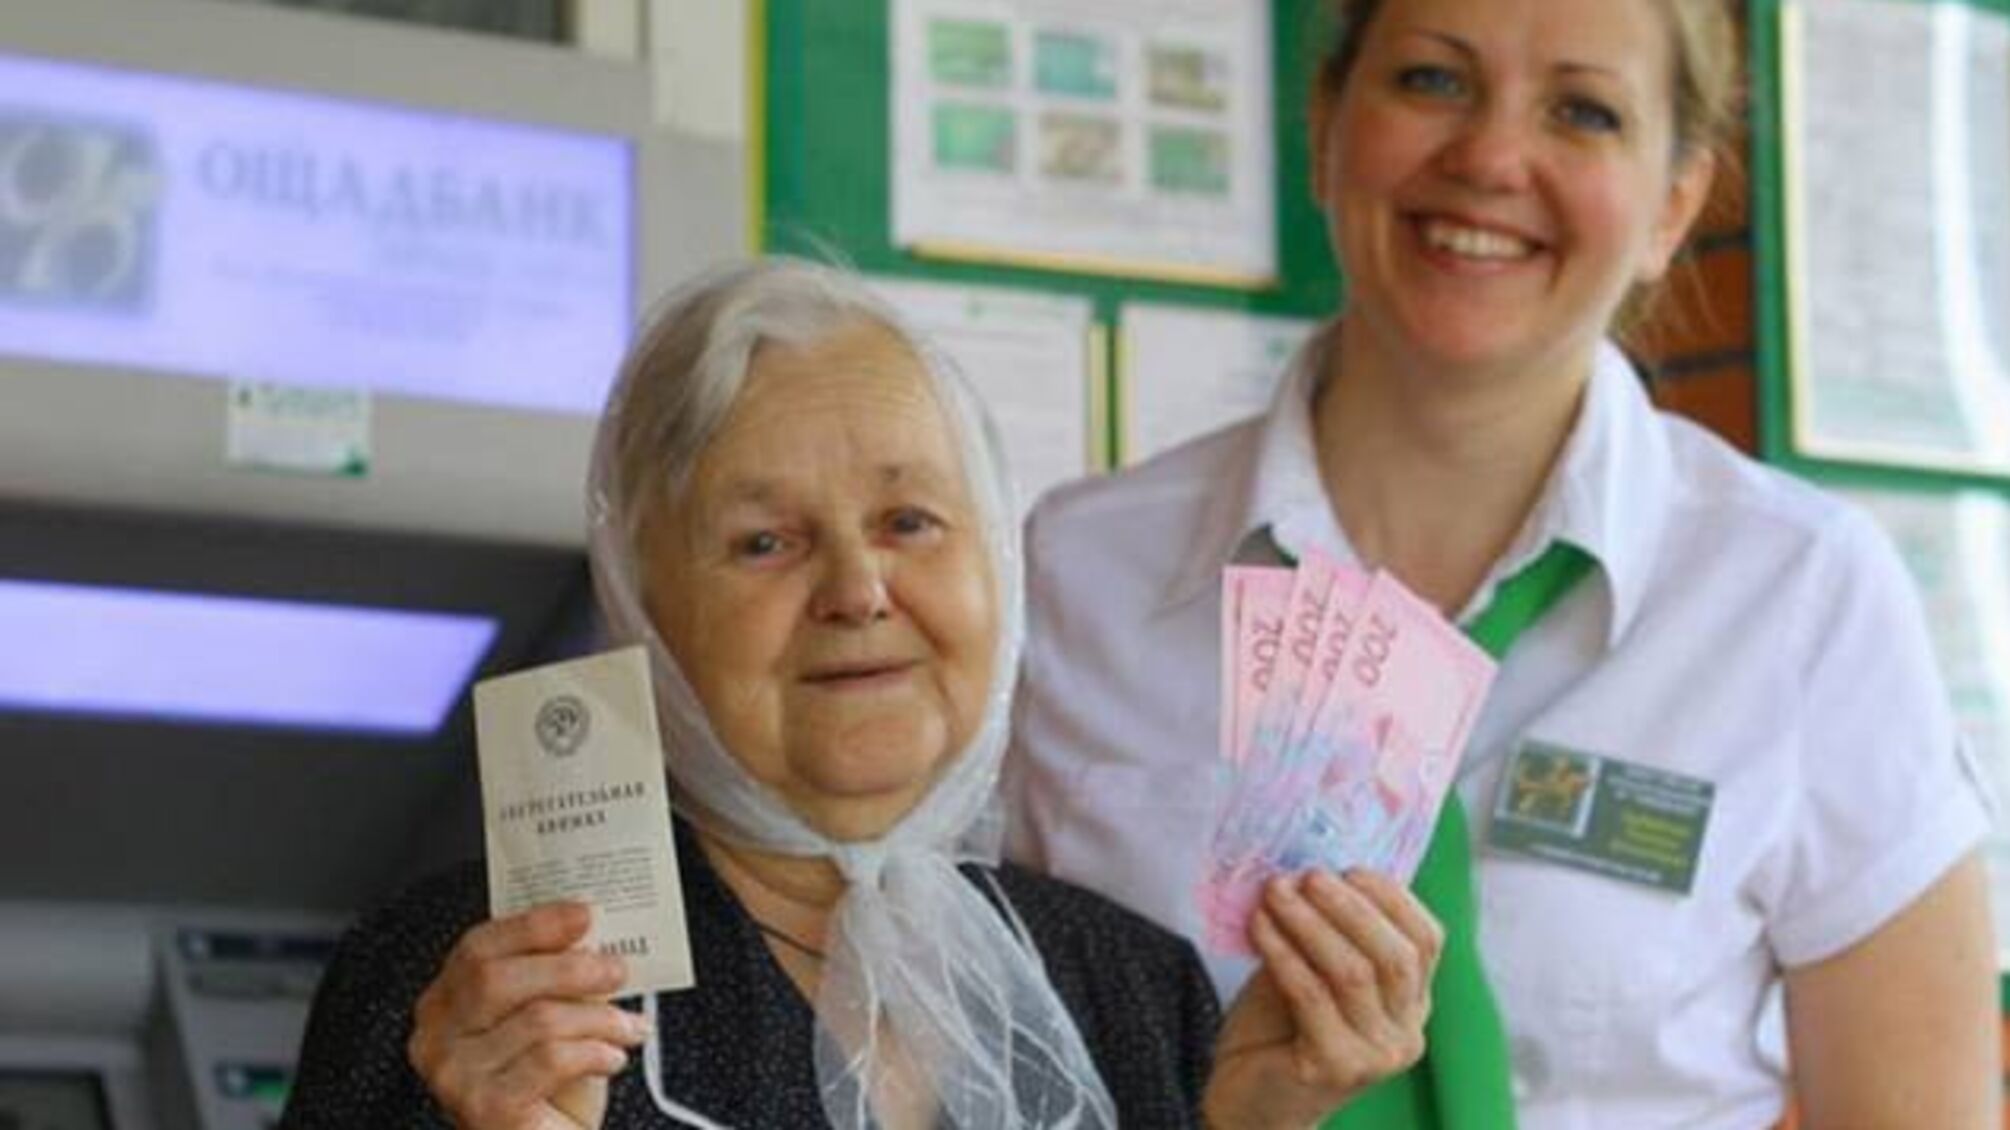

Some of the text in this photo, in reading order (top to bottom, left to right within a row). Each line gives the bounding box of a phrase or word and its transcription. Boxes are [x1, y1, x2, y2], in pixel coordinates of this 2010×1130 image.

[199, 142, 608, 246] ОЩАДБАНК
[1352, 612, 1398, 688] 200
[500, 780, 645, 821] СБЕРЕГАТЕЛЬНАЯ
